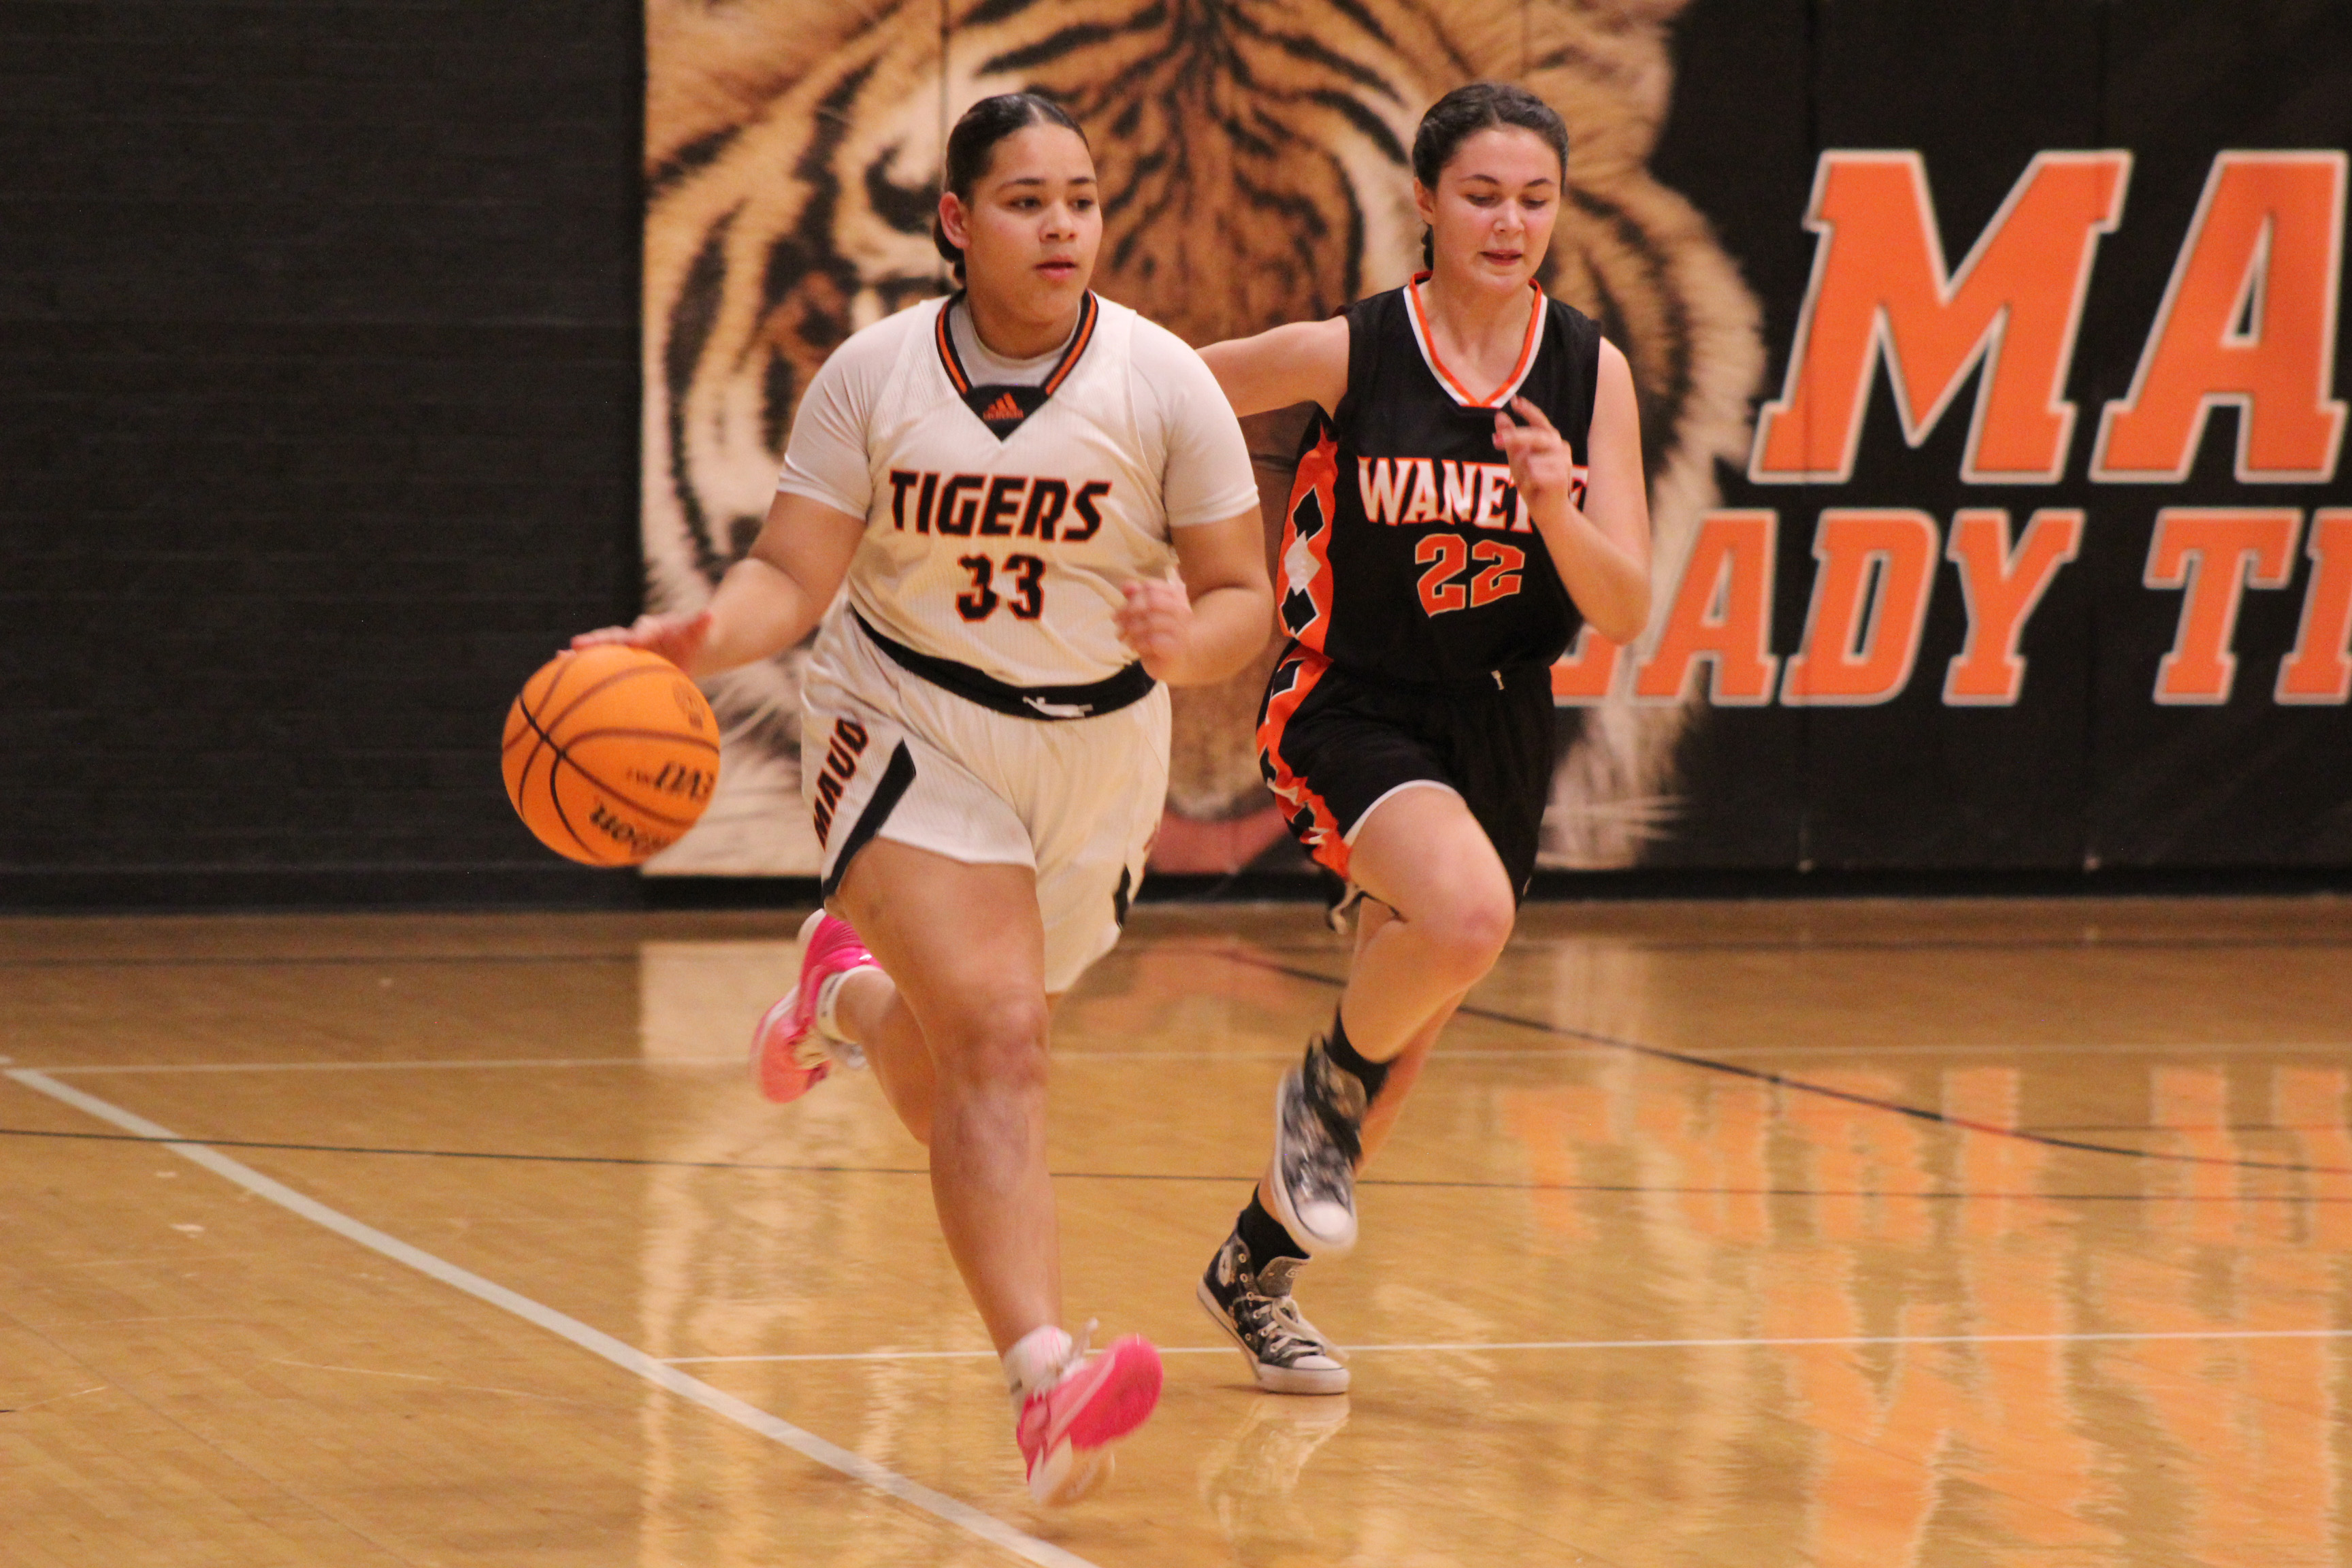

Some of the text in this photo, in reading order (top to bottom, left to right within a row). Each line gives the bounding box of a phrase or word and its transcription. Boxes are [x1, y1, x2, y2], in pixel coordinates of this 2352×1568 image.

[1748, 150, 2349, 483] MA
[889, 469, 1113, 542] TIGERS
[955, 553, 1046, 623] 33
[1415, 533, 1526, 618] 22
[813, 717, 868, 851] MAUD
